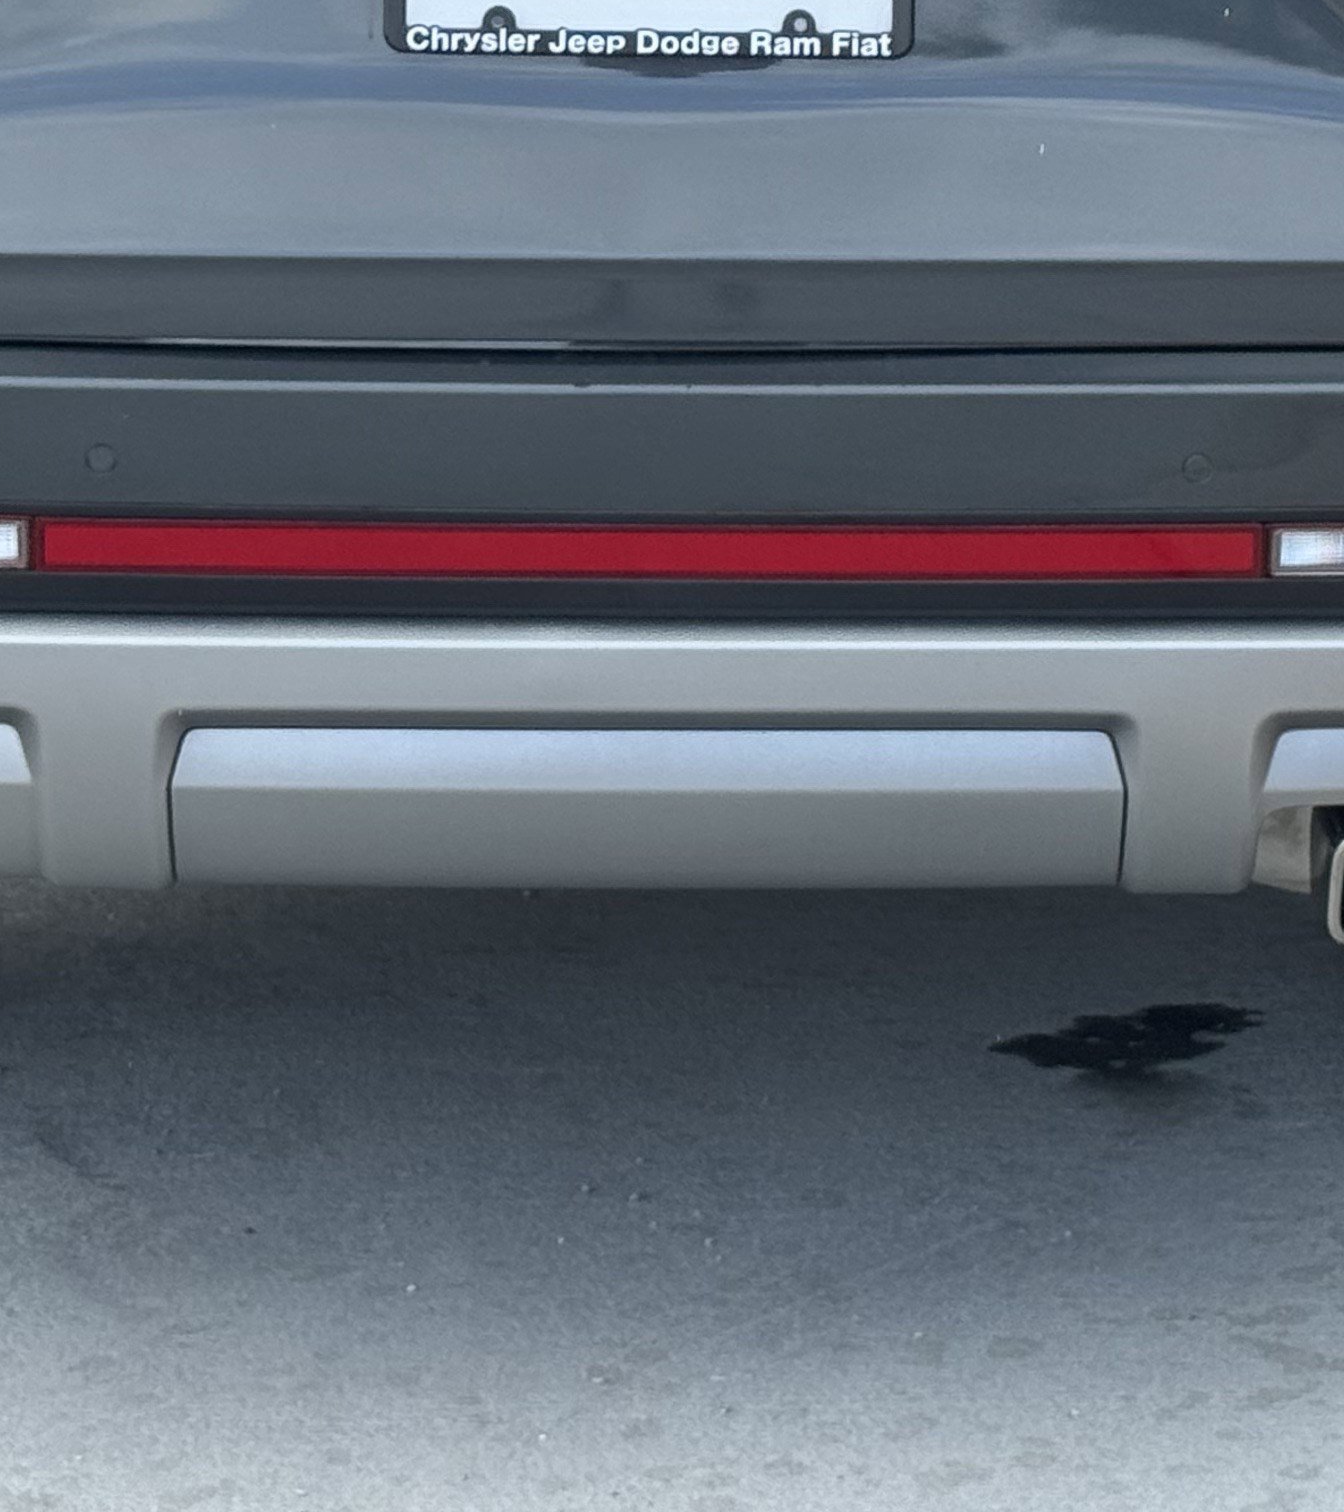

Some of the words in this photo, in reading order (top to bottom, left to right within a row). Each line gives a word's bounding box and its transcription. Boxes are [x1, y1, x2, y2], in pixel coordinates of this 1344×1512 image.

[405, 25, 541, 53] Chrysler
[548, 29, 626, 55] Jeep
[635, 30, 740, 57] Dodge
[749, 32, 822, 57] Ram
[831, 32, 893, 57] Fiat
